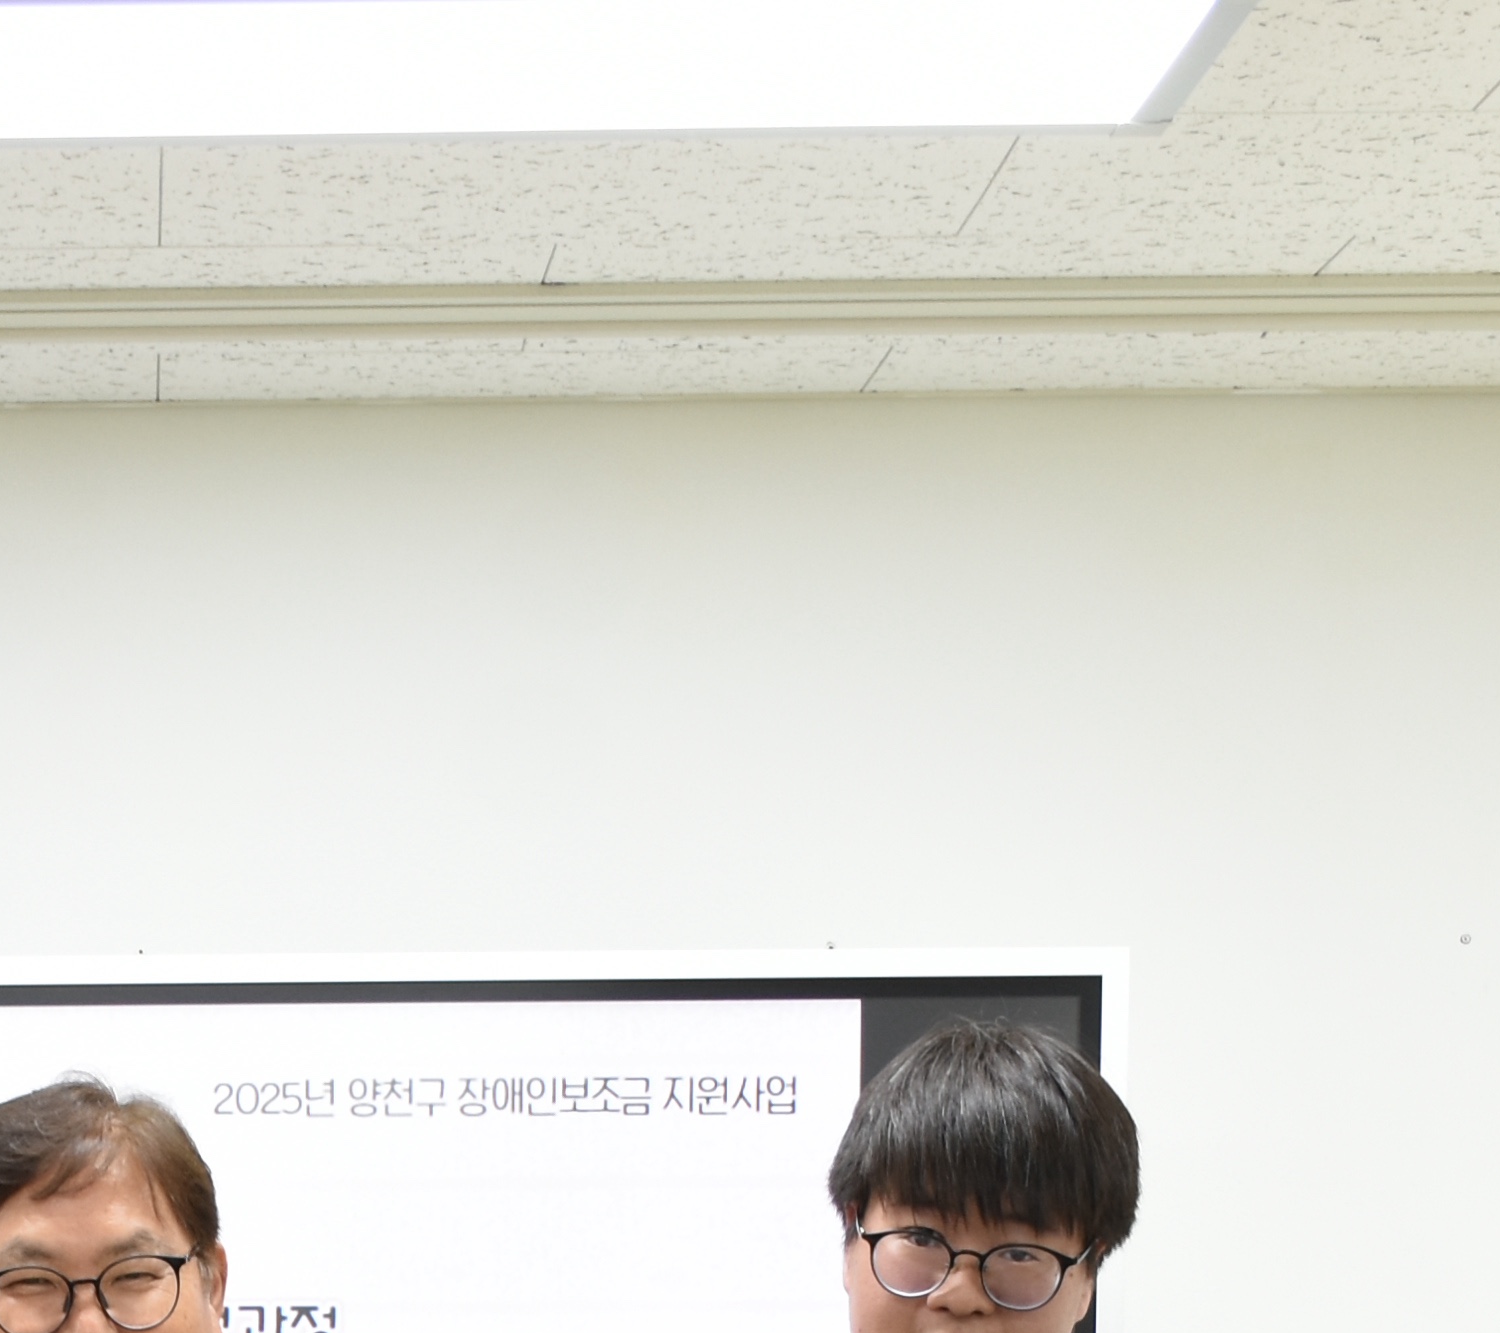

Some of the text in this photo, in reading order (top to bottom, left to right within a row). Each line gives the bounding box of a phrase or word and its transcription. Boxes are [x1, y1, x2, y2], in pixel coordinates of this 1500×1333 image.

[212, 1075, 798, 1118] 2025년 양천구 장애인보조금 지원사업
